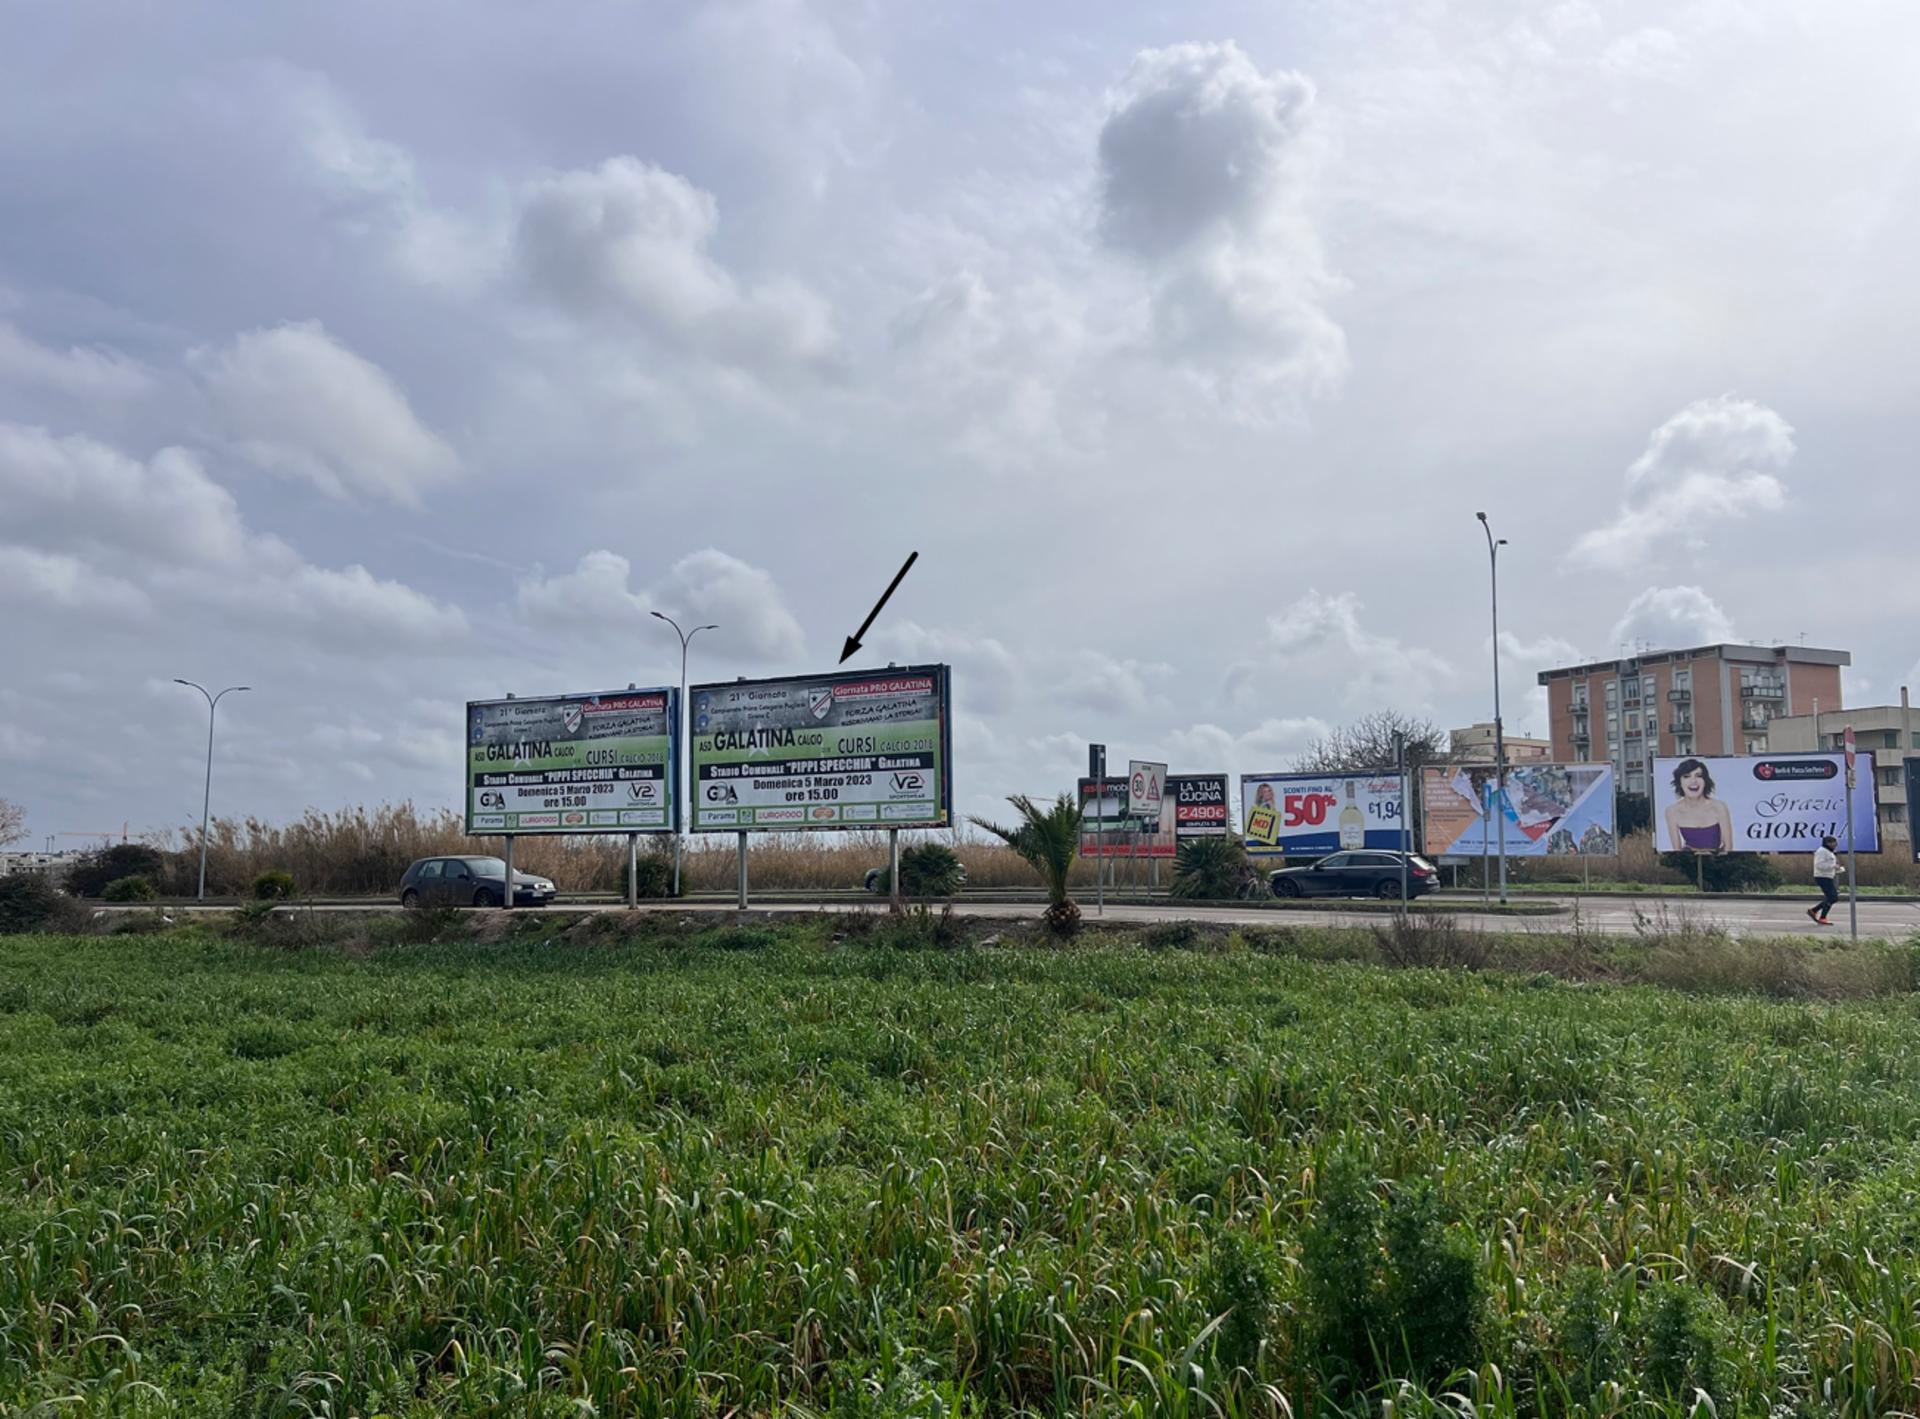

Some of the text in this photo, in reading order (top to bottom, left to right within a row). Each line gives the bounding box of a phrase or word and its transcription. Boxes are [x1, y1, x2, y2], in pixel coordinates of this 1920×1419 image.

[834, 687, 869, 696] Giornata
[870, 684, 887, 692] PRO
[889, 680, 932, 690] GALATINA
[613, 701, 627, 709] PRO
[628, 698, 664, 708] GALATINA
[730, 691, 787, 702] 21° Giornata
[845, 699, 917, 717] FORZA GALATINA
[593, 716, 651, 733] FORZA GALATINA
[699, 727, 823, 752] ASD GALATINA CALCIO
[838, 737, 876, 754] CURSI
[880, 740, 911, 752] CALCIO
[914, 739, 934, 750] 2018
[475, 740, 575, 762] ASD GALATINA CALCIO
[586, 749, 618, 765] CURSI
[620, 752, 645, 763] CALCIO
[786, 761, 818, 774] "PIPPI
[820, 757, 876, 772] SPECCHIA"
[544, 771, 570, 782] "PIPPI
[571, 768, 617, 781] SPECCHIA"
[754, 774, 872, 790] Domenica 5 Marzo 2023
[894, 772, 923, 790] V2
[517, 784, 614, 797] Domenica 5 Marzo 2023
[631, 782, 655, 798] V2
[1135, 779, 1144, 792] 30
[1180, 781, 1221, 792] LA TUA
[1283, 786, 1307, 794] SCONTI
[544, 796, 587, 808] ore 15.00
[785, 788, 838, 801] ore 15.00
[1180, 791, 1221, 802] CUCINA
[708, 812, 736, 820] Parama
[1179, 807, 1225, 819] 2.490€
[1284, 794, 1337, 827] 50%
